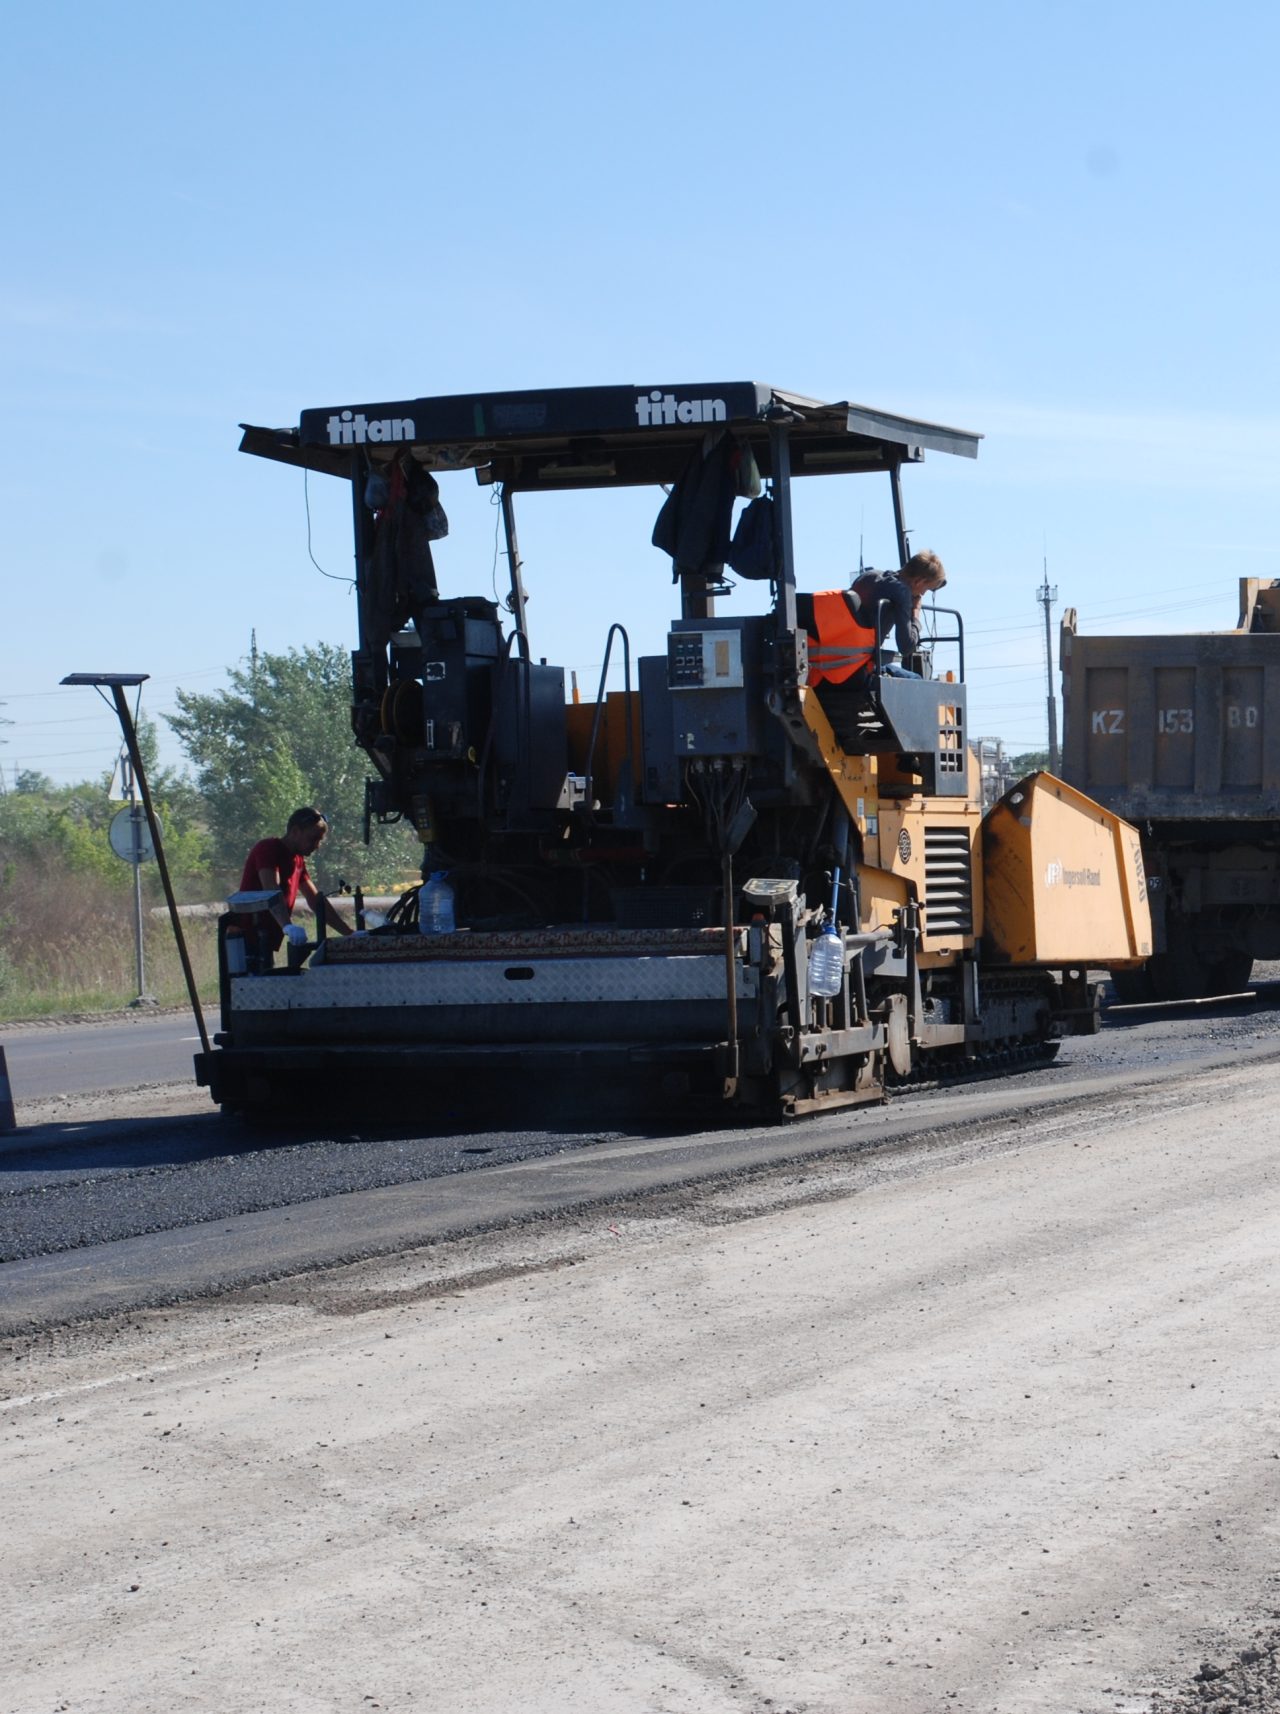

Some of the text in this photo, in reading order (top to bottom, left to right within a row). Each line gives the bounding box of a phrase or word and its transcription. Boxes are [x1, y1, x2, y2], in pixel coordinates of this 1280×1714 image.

[635, 390, 727, 426] titan
[326, 410, 416, 445] titan
[1092, 710, 1125, 734] KZ
[1158, 709, 1193, 733] 153
